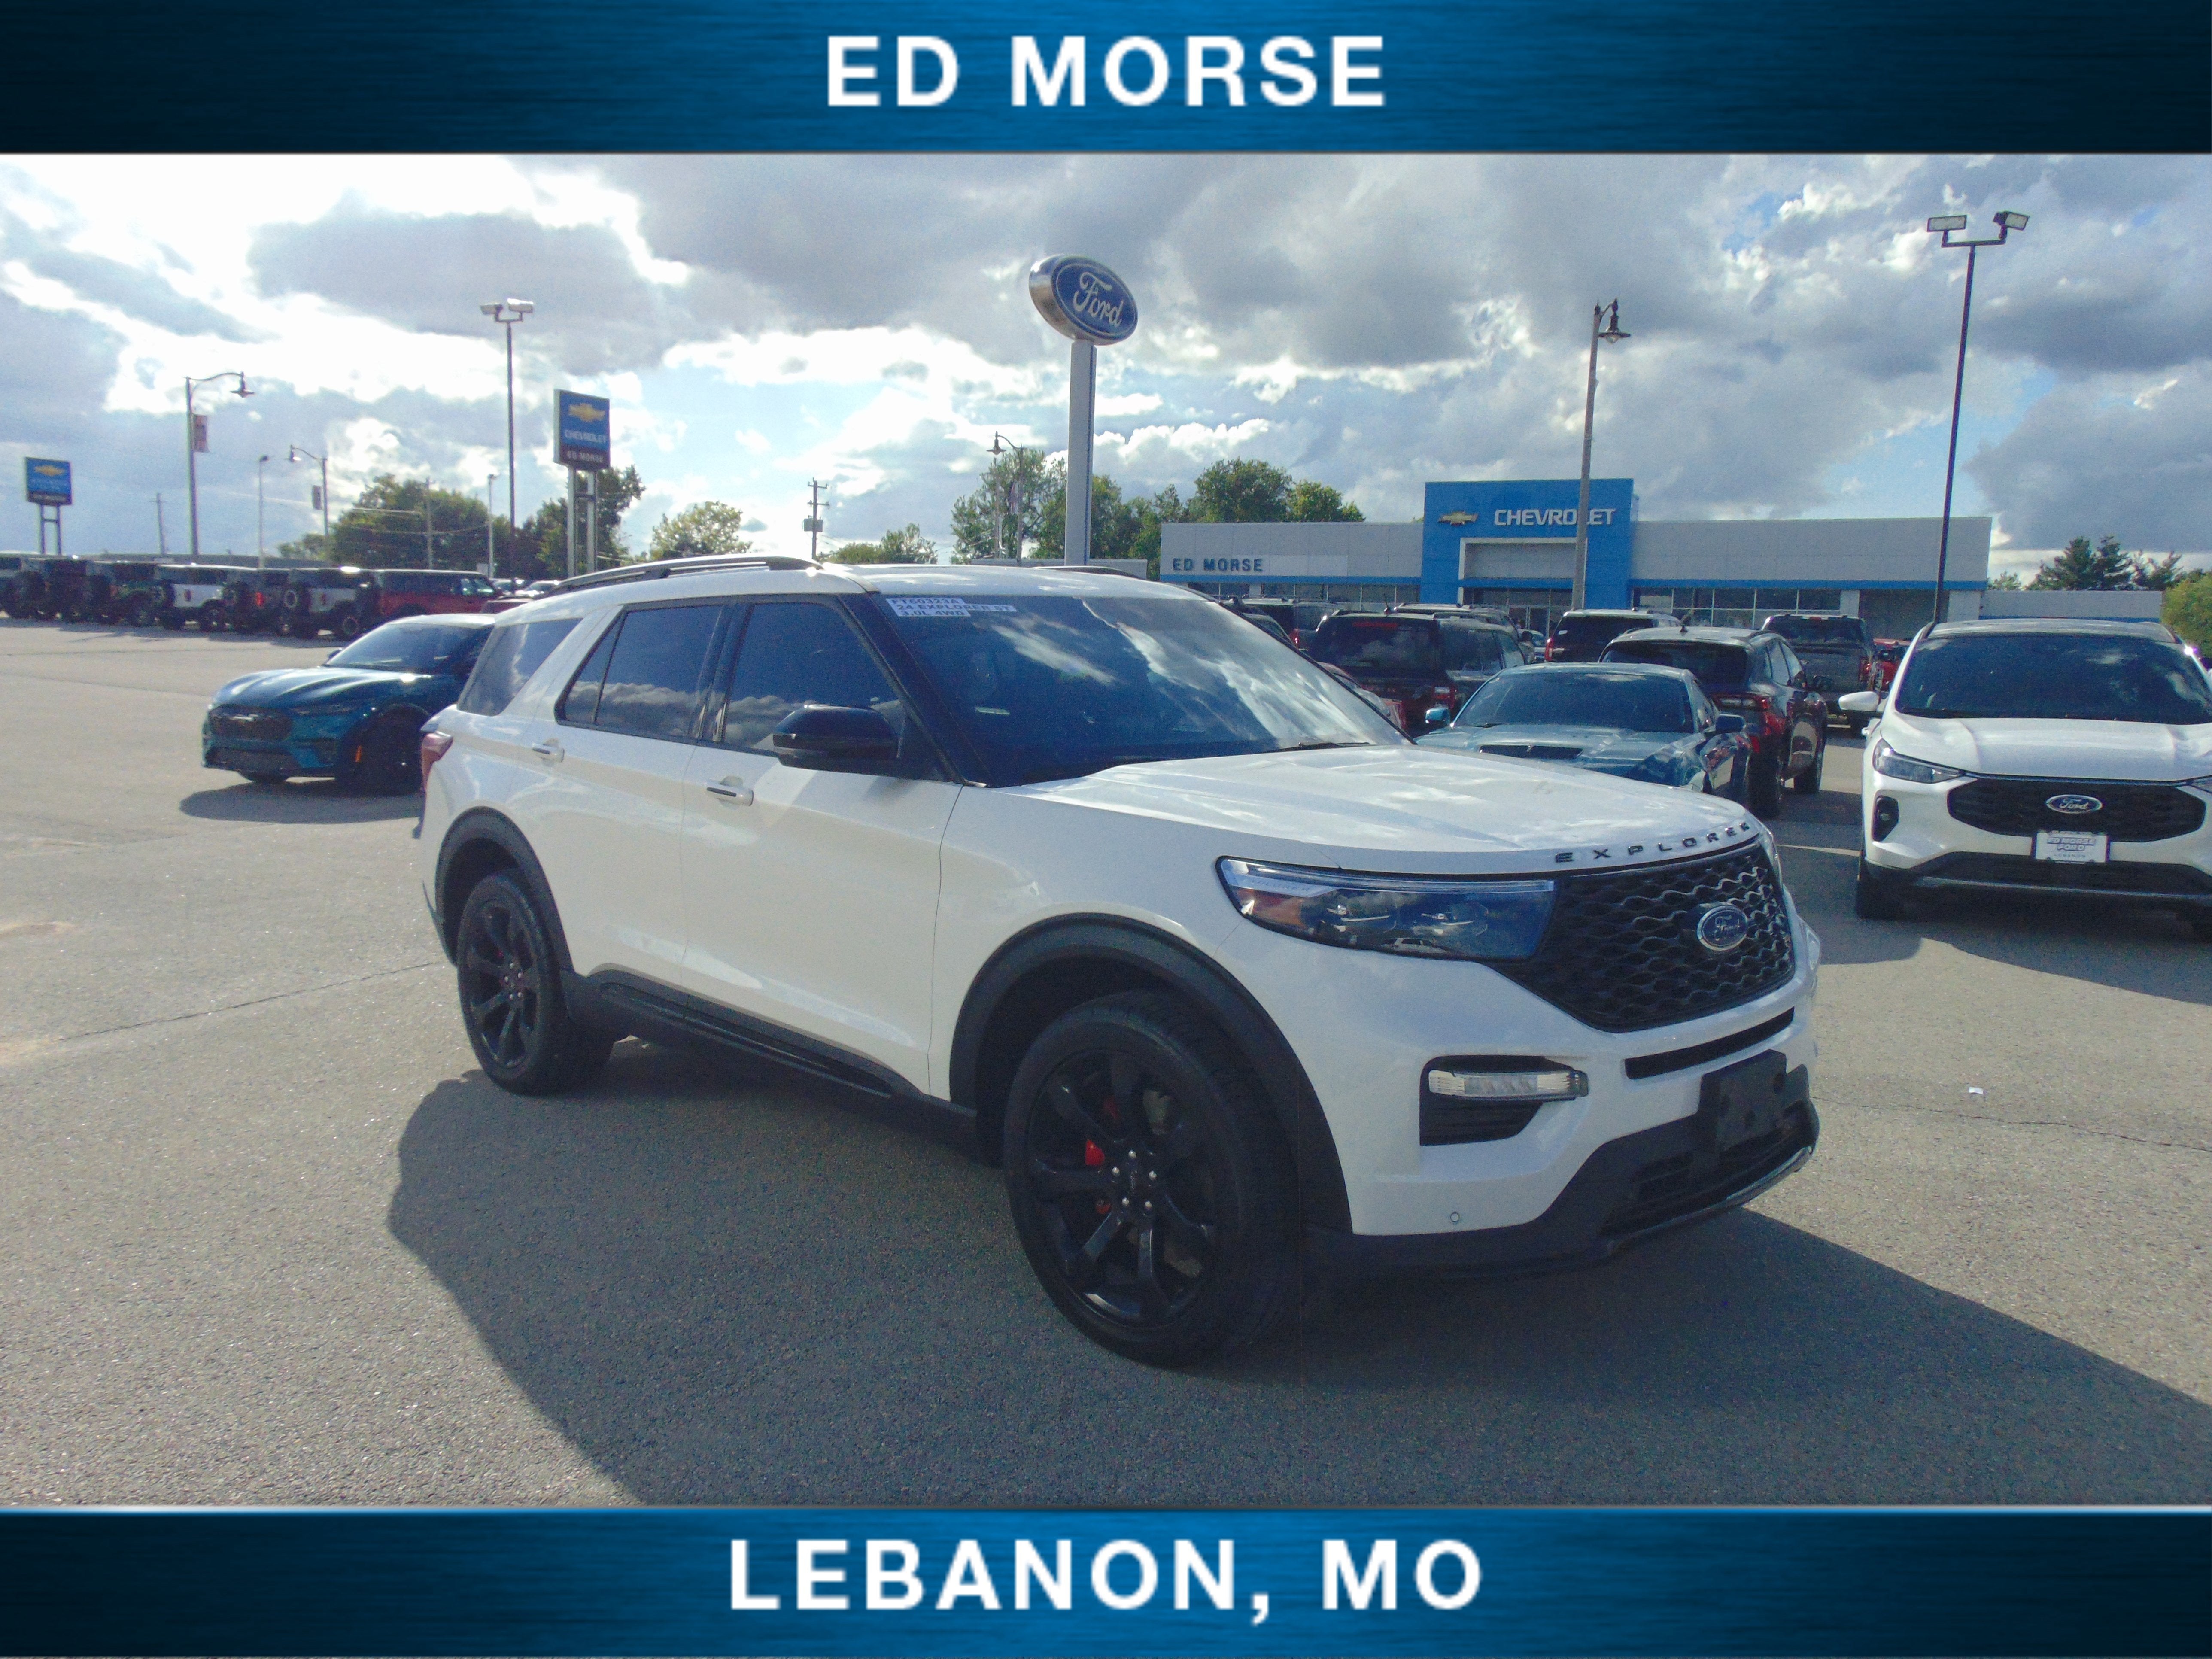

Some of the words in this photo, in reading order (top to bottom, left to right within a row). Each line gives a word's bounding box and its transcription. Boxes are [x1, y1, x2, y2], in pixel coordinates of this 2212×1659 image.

[1073, 271, 1124, 328] Ford
[1494, 508, 1616, 526] CHEVROET
[1173, 558, 1193, 571] ED
[1203, 558, 1264, 572] MORSE
[2059, 797, 2089, 810] Ford
[1555, 821, 1750, 863] EXPLORER
